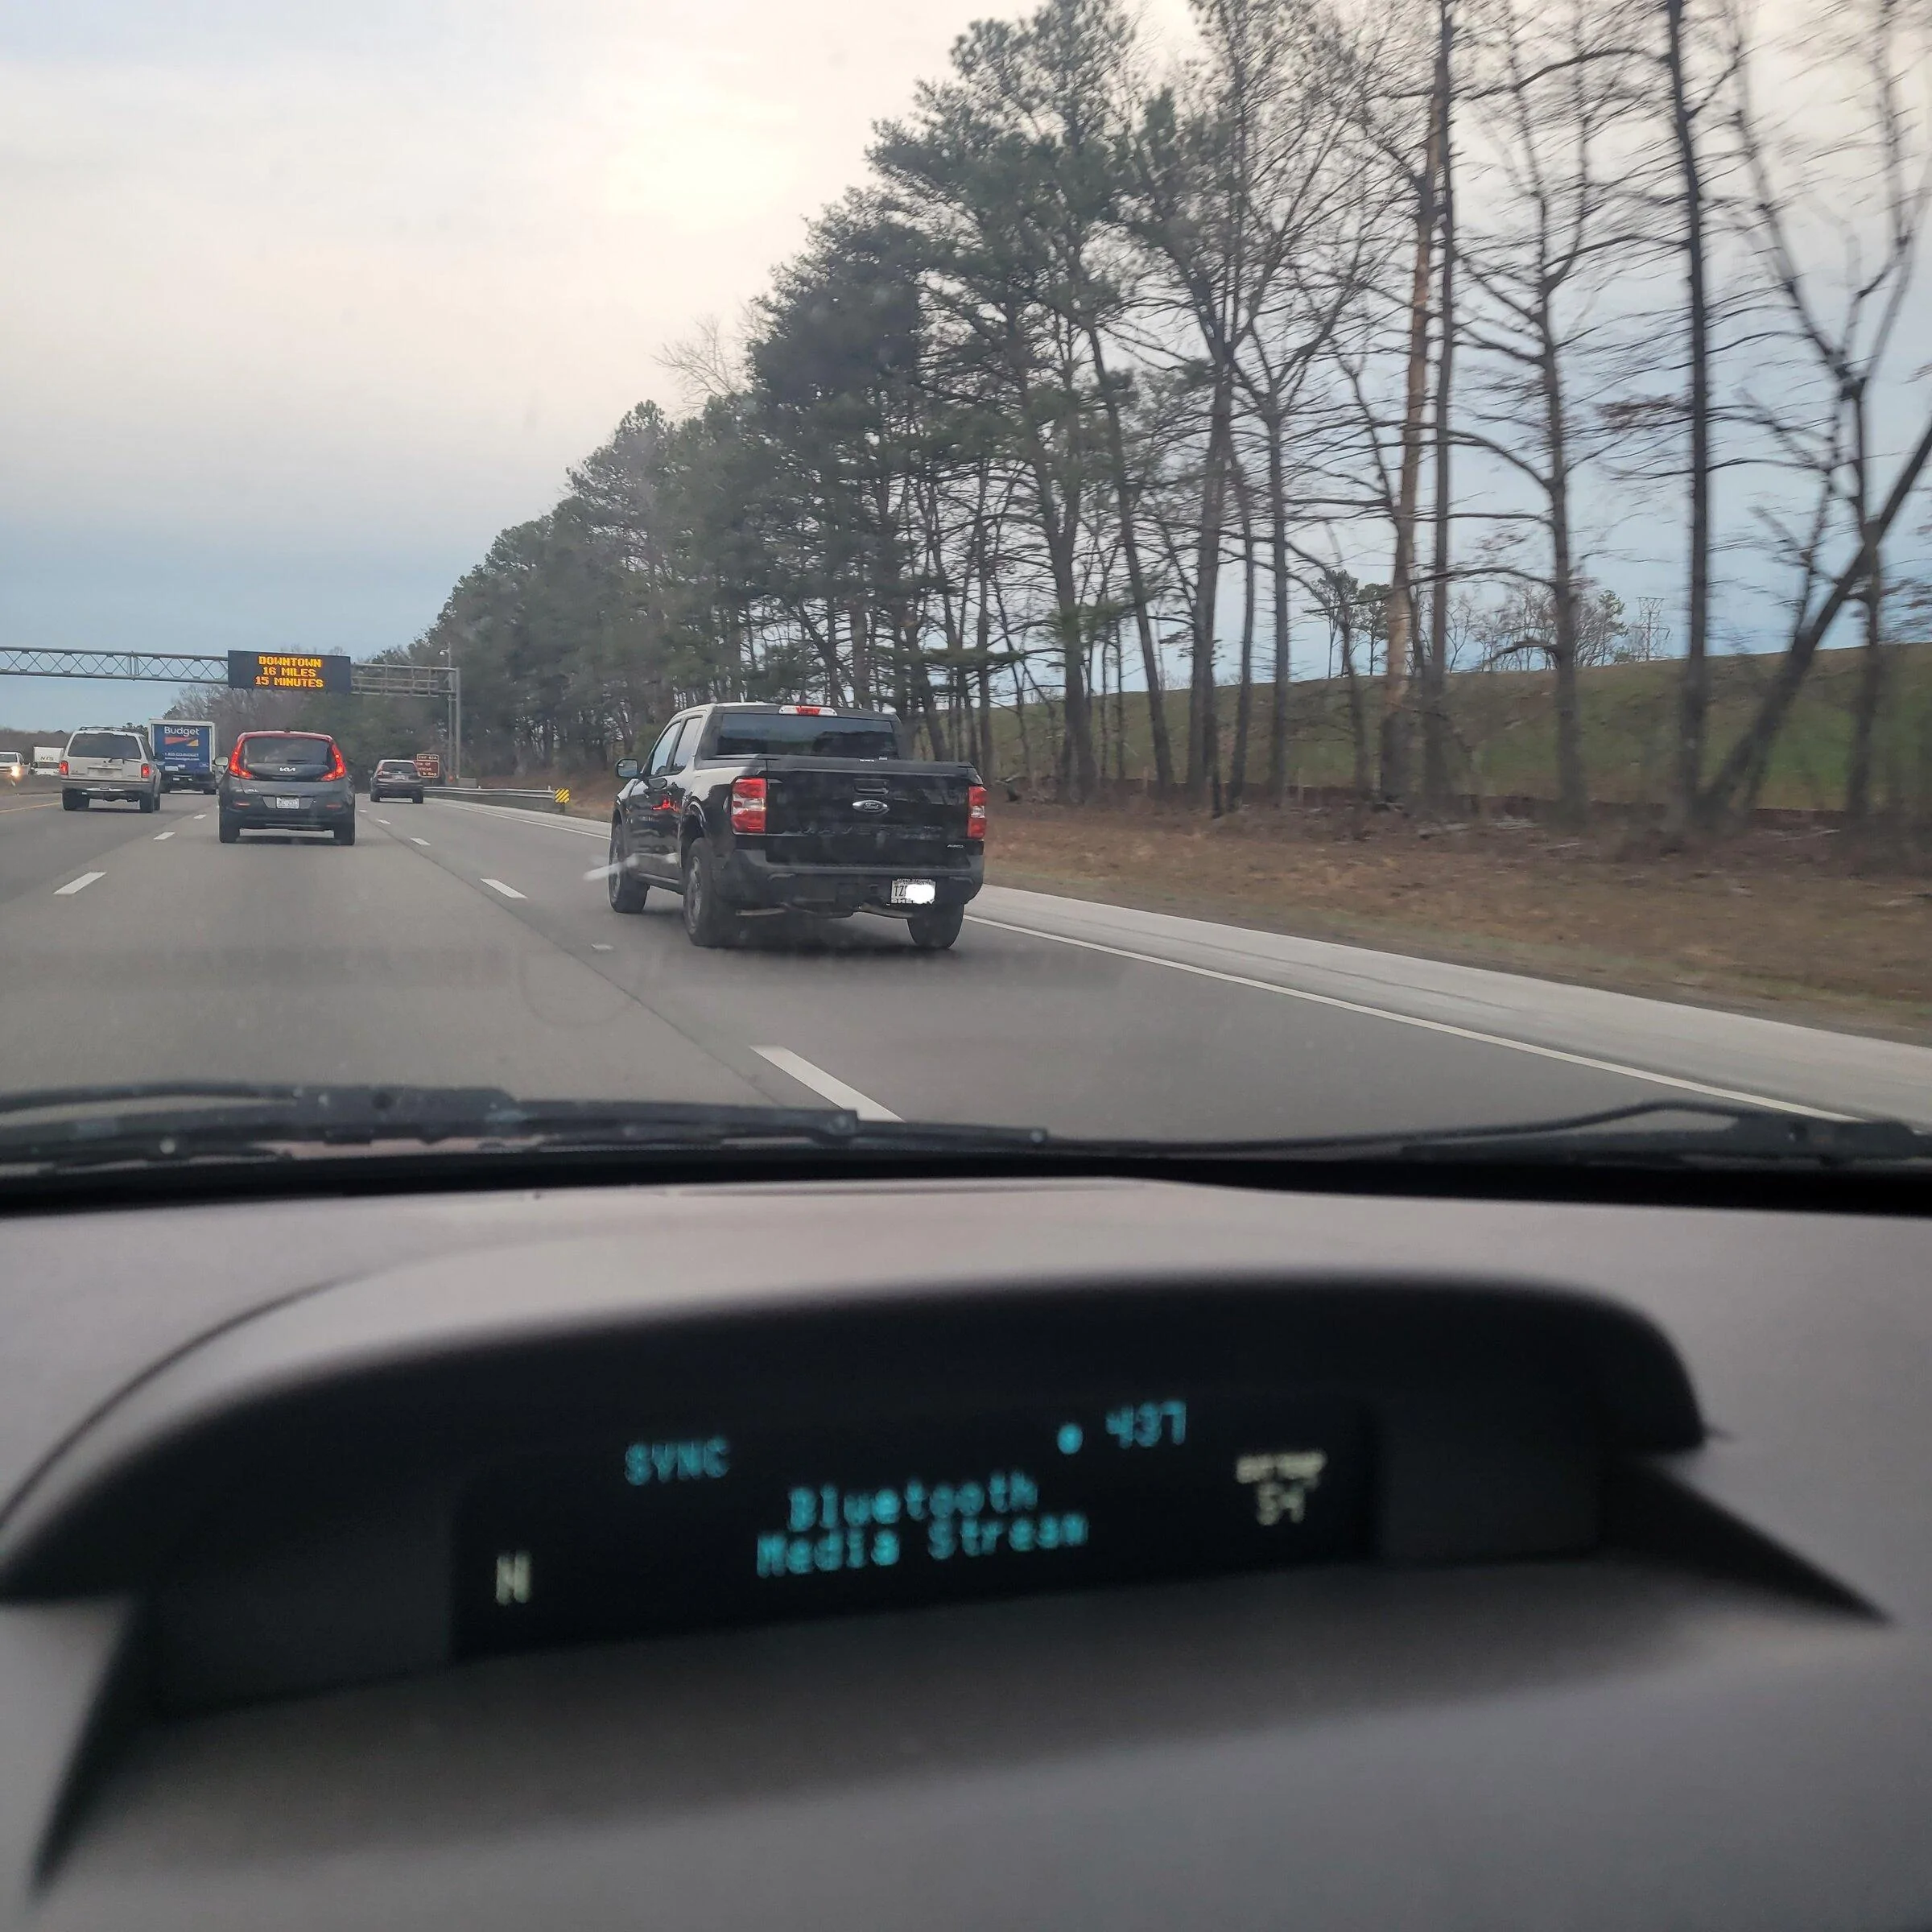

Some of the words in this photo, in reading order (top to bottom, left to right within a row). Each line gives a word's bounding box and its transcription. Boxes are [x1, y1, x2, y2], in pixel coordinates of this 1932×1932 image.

[258, 655, 321, 668] DOWNTOWN
[262, 667, 277, 675] 16
[281, 668, 316, 677] MILES
[255, 676, 270, 685] 15
[274, 677, 324, 687] MINUTES
[164, 726, 200, 737] Budget
[625, 1438, 728, 1485] SYNC
[788, 1470, 1038, 1531] Bluetooth
[756, 1529, 899, 1577] Media
[928, 1514, 1087, 1559] Stream
